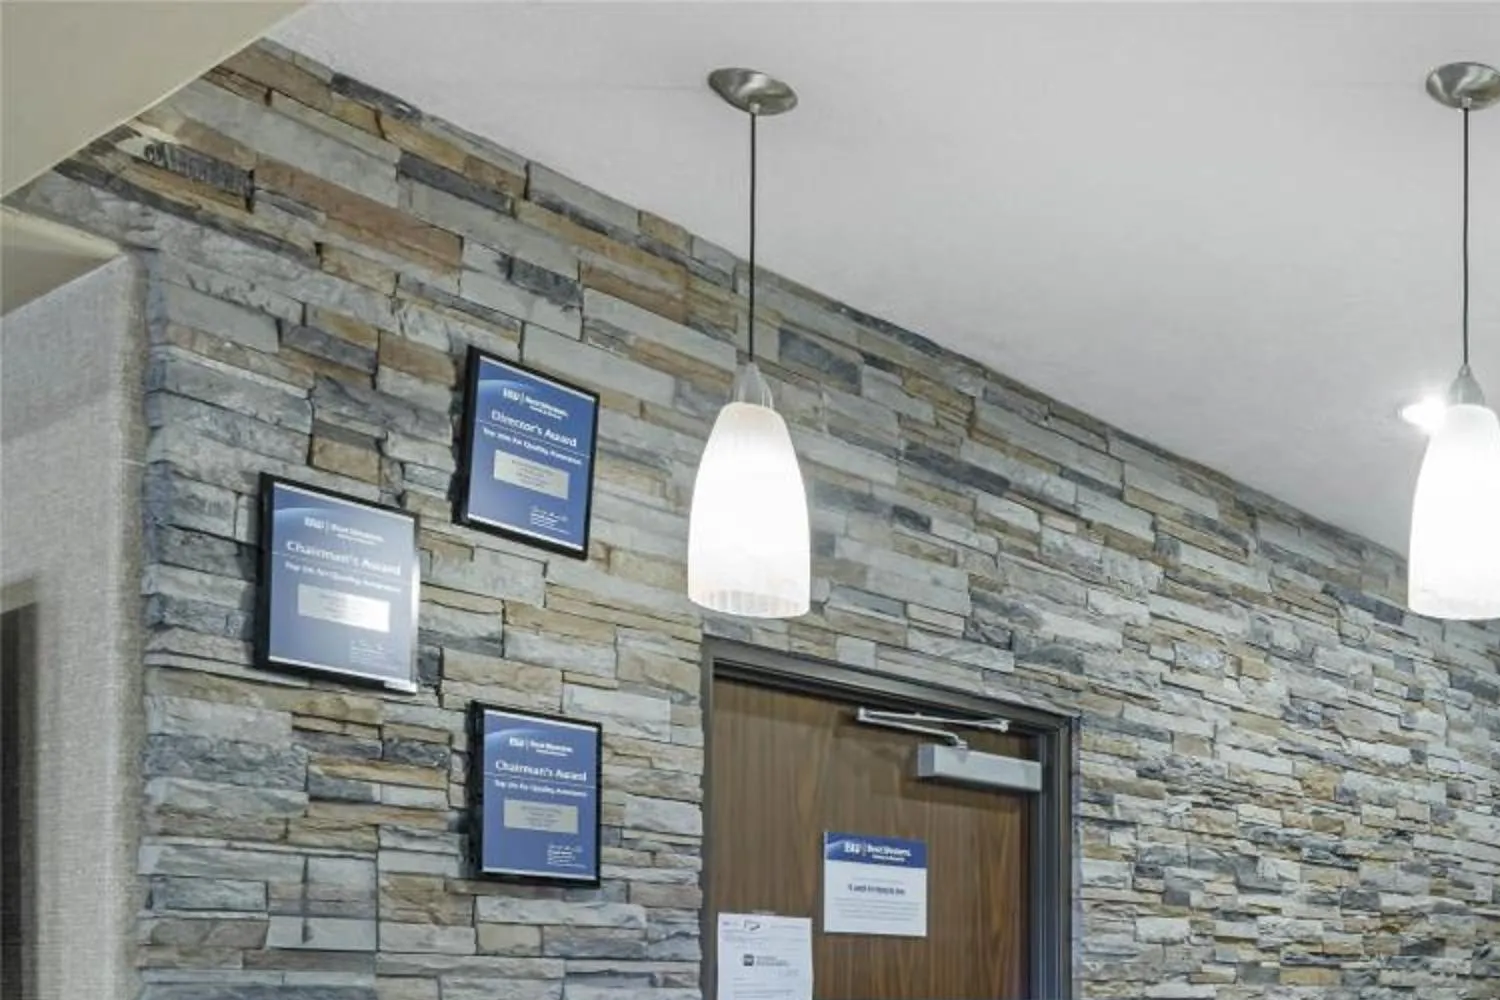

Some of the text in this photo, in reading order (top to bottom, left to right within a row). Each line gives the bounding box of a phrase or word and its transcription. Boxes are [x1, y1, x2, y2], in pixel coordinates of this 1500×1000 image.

[491, 409, 543, 435] Director's
[544, 427, 577, 448] Award
[286, 540, 402, 577] Chairman's Award
[495, 759, 588, 782] Chairman's Award
